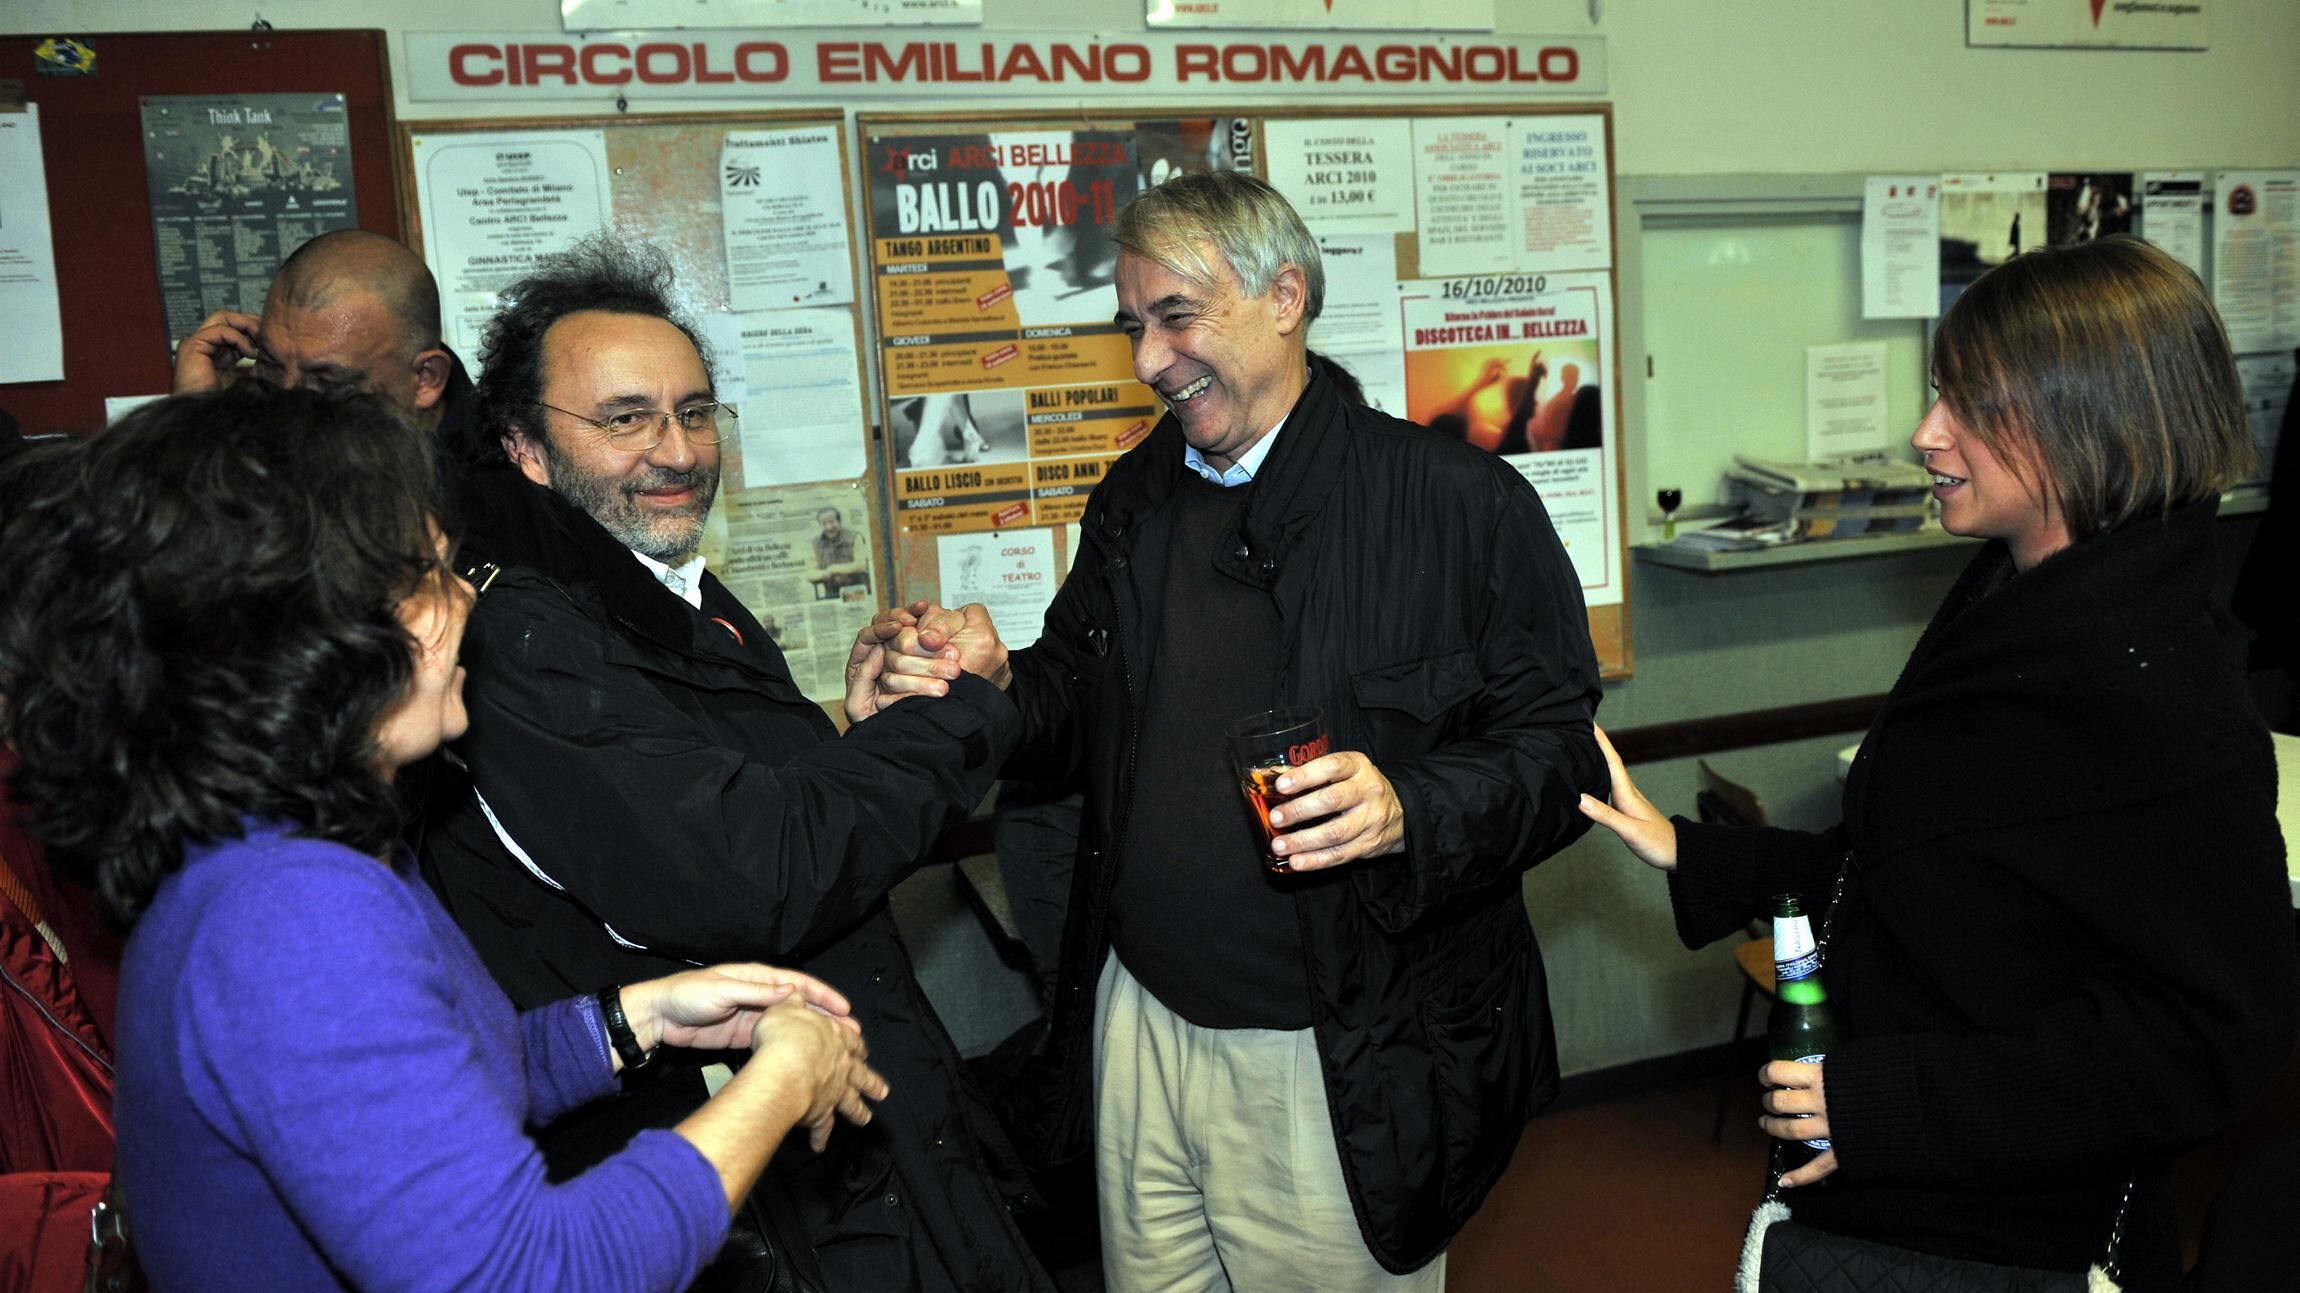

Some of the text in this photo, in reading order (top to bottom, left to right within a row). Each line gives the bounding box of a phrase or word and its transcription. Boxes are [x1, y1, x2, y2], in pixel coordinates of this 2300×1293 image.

[449, 42, 1579, 86] CIRCOLO EMILIANO ROMAGNOLO
[208, 107, 272, 124] Think Tank
[946, 144, 1004, 168] ARCI
[1011, 141, 1129, 167] BELLEZZA
[1231, 117, 1251, 172] ngo
[1304, 151, 1374, 165] TESSERA
[1304, 170, 1377, 185] ARCI 2010
[896, 179, 1115, 233] BALLO 2010-11
[885, 238, 991, 257] TANGO ARGENTINO
[1442, 276, 1547, 299] 16/10/2010
[1025, 327, 1073, 338] DOMENICA
[1415, 325, 1493, 345] DISCOTECA
[1523, 319, 1588, 339] BELLEZZA
[1030, 387, 1119, 409] BALLI POPOLARI
[1037, 463, 1069, 482] DISCO
[1073, 461, 1100, 479] ANNI
[905, 474, 940, 493] BALLO
[944, 471, 982, 489] LISCIO
[1038, 486, 1074, 497] SABATO
[907, 497, 944, 508] SABATO
[1000, 546, 1035, 557] CORSO
[1001, 571, 1041, 583] TEATRO
